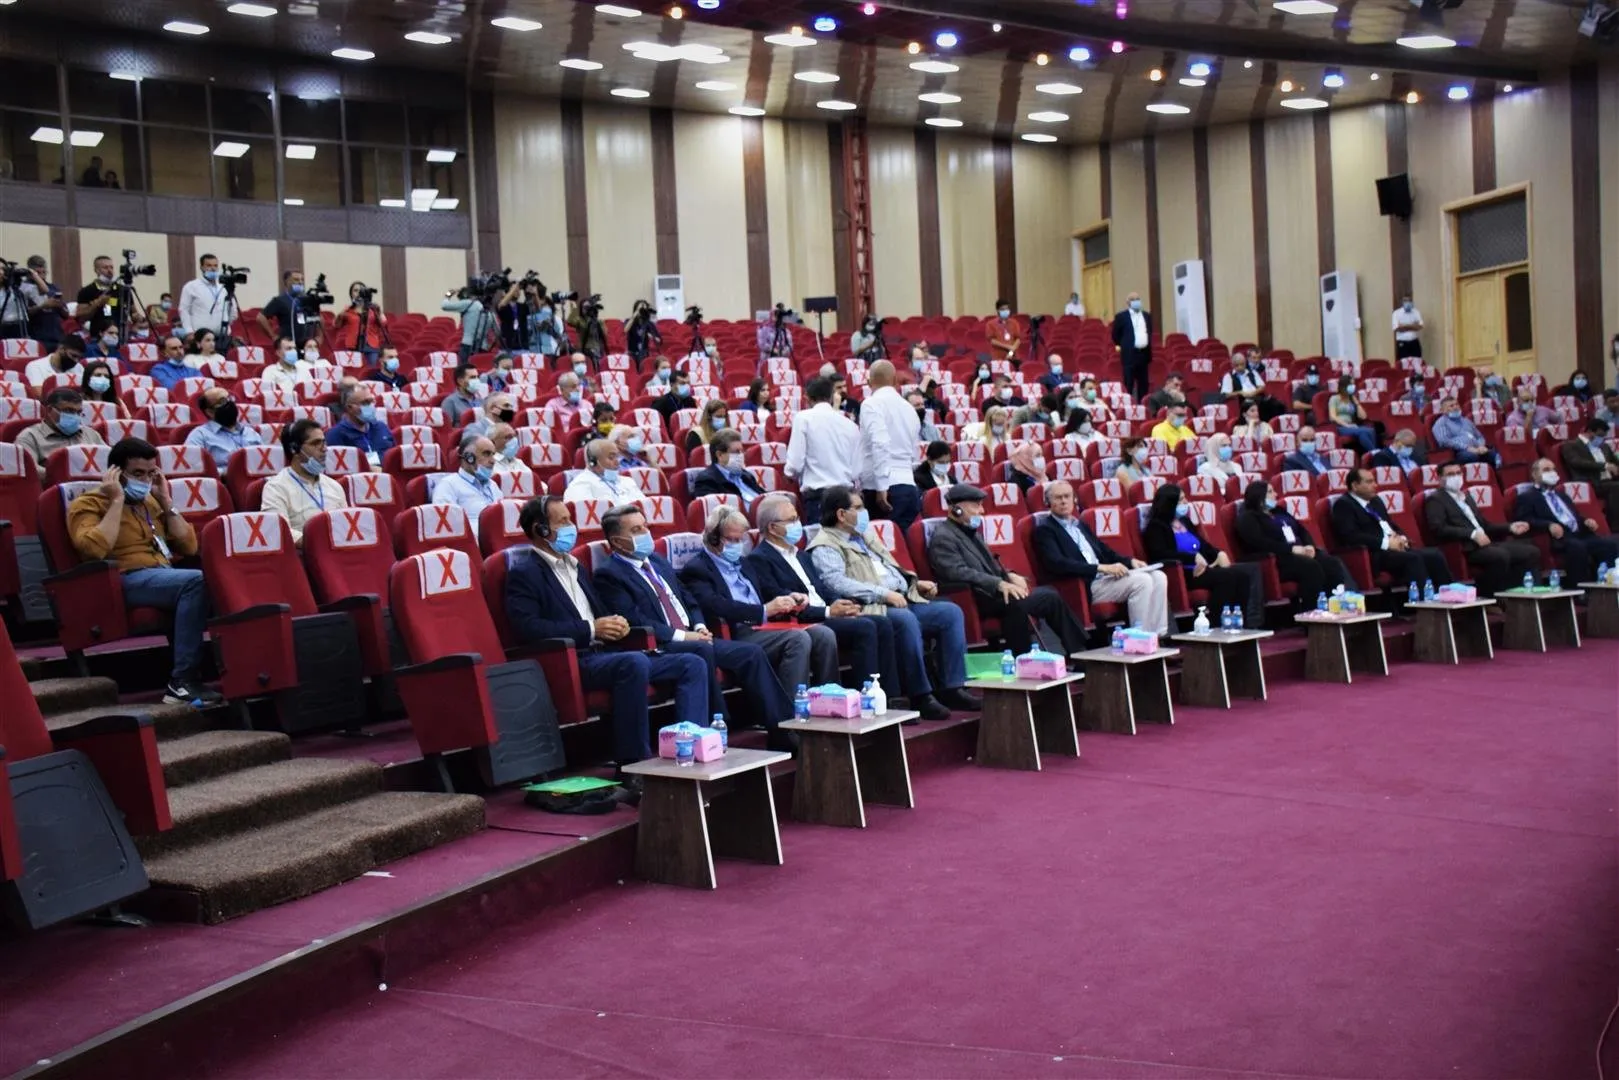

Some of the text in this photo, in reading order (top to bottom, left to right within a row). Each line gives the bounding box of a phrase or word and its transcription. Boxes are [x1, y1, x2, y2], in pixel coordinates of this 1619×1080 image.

[17, 341, 28, 355] X
[138, 346, 149, 358] X
[246, 349, 255, 360] X
[346, 352, 354, 364] X
[326, 368, 335, 380] X
[610, 372, 618, 383] X
[196, 380, 204, 392] X
[420, 385, 429, 398] X
[521, 386, 528, 398] X
[147, 388, 157, 400] X
[275, 392, 285, 406] X
[8, 400, 22, 418] X
[392, 395, 402, 409] X
[92, 404, 106, 421] X
[166, 406, 180, 423] X
[239, 408, 248, 421] X
[424, 408, 434, 423] X
[535, 410, 546, 424] X
[689, 412, 698, 424] X
[736, 412, 746, 426] X
[411, 429, 422, 444] X
[530, 429, 542, 444] X
[642, 429, 653, 444] X
[748, 427, 758, 441] X
[940, 428, 948, 440] X
[541, 446, 551, 461] X
[770, 444, 780, 461] X
[967, 443, 976, 457] X
[1060, 440, 1069, 452] X
[1106, 441, 1114, 452] X
[82, 447, 100, 472] X
[172, 448, 191, 470] X
[258, 448, 274, 470] X
[334, 449, 348, 470] X
[413, 446, 425, 463] X
[656, 447, 668, 464] X
[1252, 454, 1260, 468] X
[1339, 452, 1348, 464] X
[962, 465, 972, 480] X
[1064, 461, 1074, 476] X
[1158, 458, 1166, 472] X
[639, 470, 652, 490] X
[1292, 473, 1303, 488] X
[1384, 467, 1392, 481] X
[364, 475, 381, 500] X
[511, 472, 524, 493] X
[1102, 481, 1112, 494] X
[1196, 478, 1205, 493] X
[185, 480, 207, 507] X
[1000, 484, 1010, 500] X
[1478, 488, 1484, 503] X
[1573, 486, 1582, 499] X
[652, 498, 665, 520] X
[1292, 500, 1300, 516] X
[1387, 494, 1395, 512] X
[435, 505, 453, 533] X
[585, 500, 600, 525] X
[344, 511, 364, 541] X
[994, 518, 1005, 541] X
[1102, 512, 1112, 532] X
[246, 516, 268, 547] X
[438, 552, 458, 588] X
